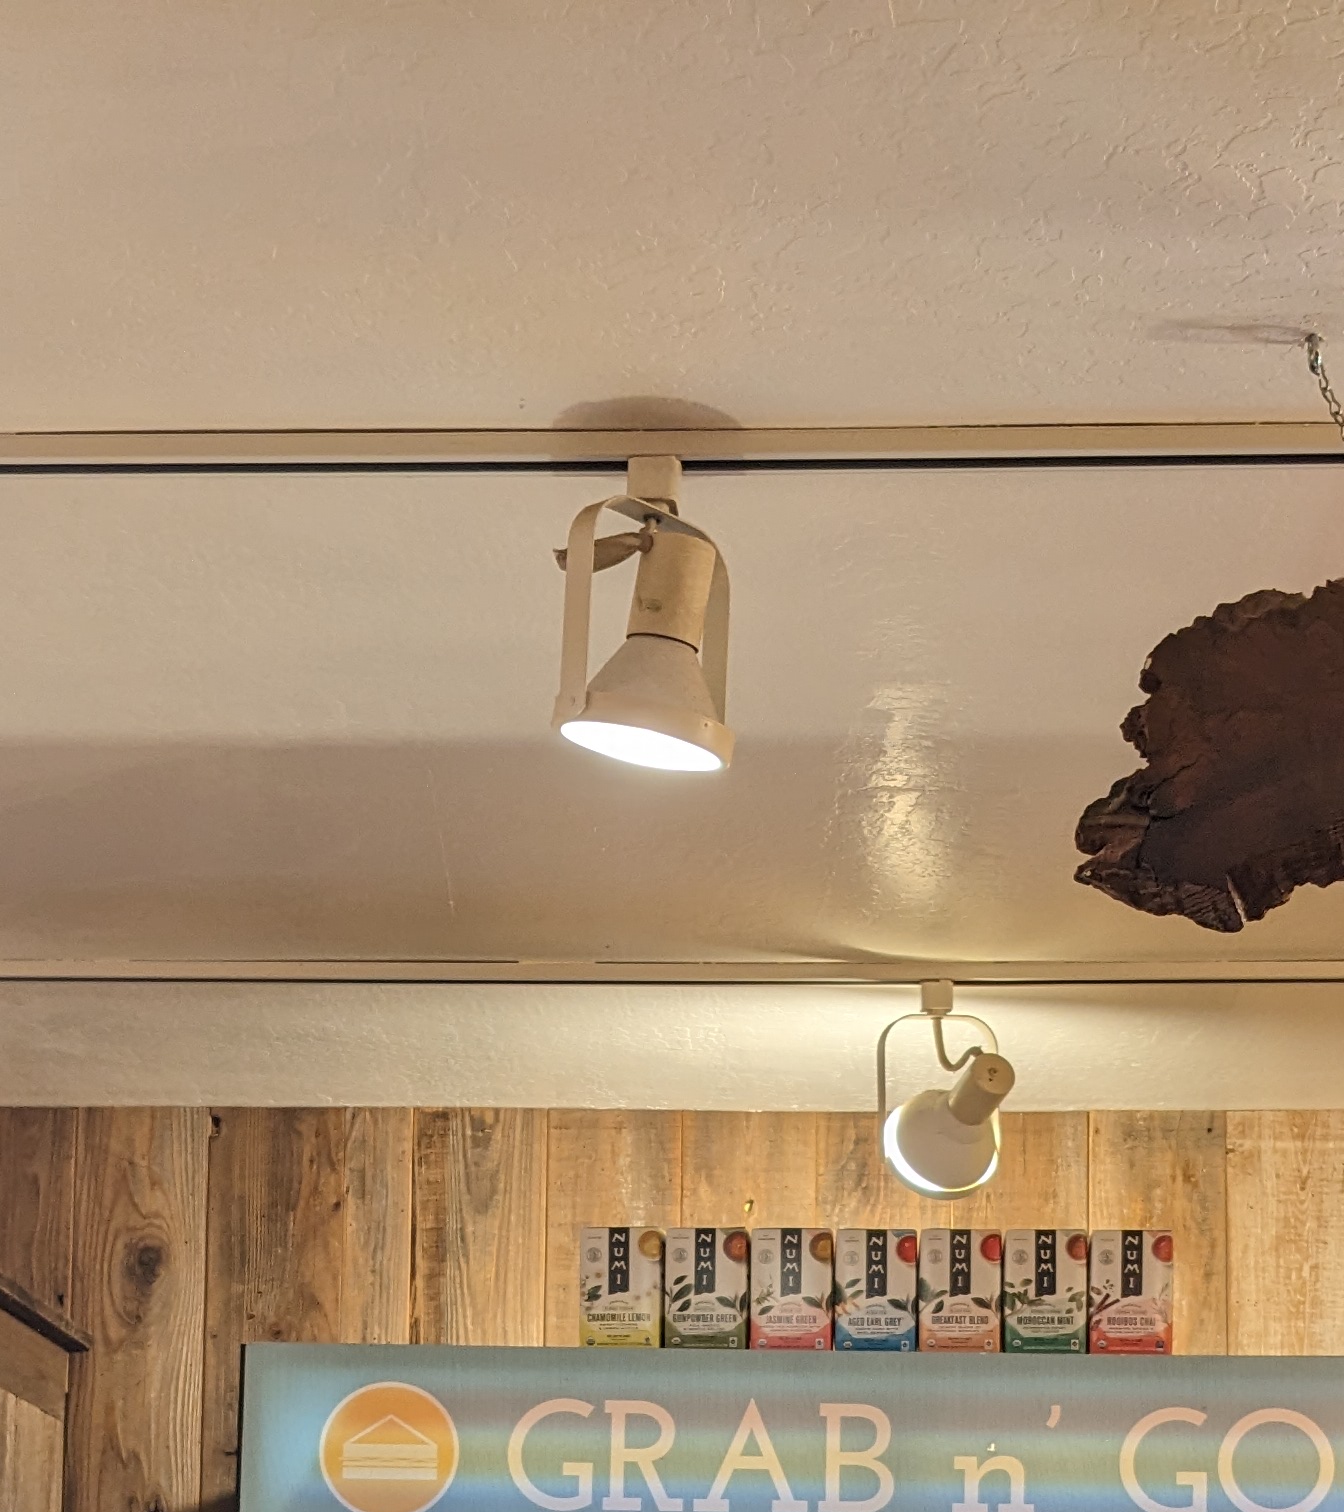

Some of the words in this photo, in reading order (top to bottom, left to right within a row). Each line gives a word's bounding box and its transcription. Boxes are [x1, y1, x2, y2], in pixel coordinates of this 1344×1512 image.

[611, 1232, 627, 1286] NUMI
[697, 1232, 713, 1286] NUMI
[783, 1234, 799, 1288] NUMI
[869, 1236, 884, 1290] NUMI
[953, 1234, 968, 1288] NUMI
[1038, 1234, 1053, 1288] NUMI
[1124, 1235, 1140, 1290] NUMI
[587, 1312, 627, 1323] CHAMOMILE
[628, 1312, 651, 1323] LEMON
[672, 1312, 714, 1324] GUNPOWDER
[715, 1312, 738, 1324] GREEN
[766, 1314, 794, 1325] JASMINE
[795, 1314, 817, 1325] GREEN
[884, 1316, 903, 1327] GREY
[931, 1315, 968, 1326] BREAKFAST
[969, 1315, 989, 1326] BLEND
[1016, 1315, 1056, 1326] MOROCCAN
[1057, 1315, 1075, 1326] MINT
